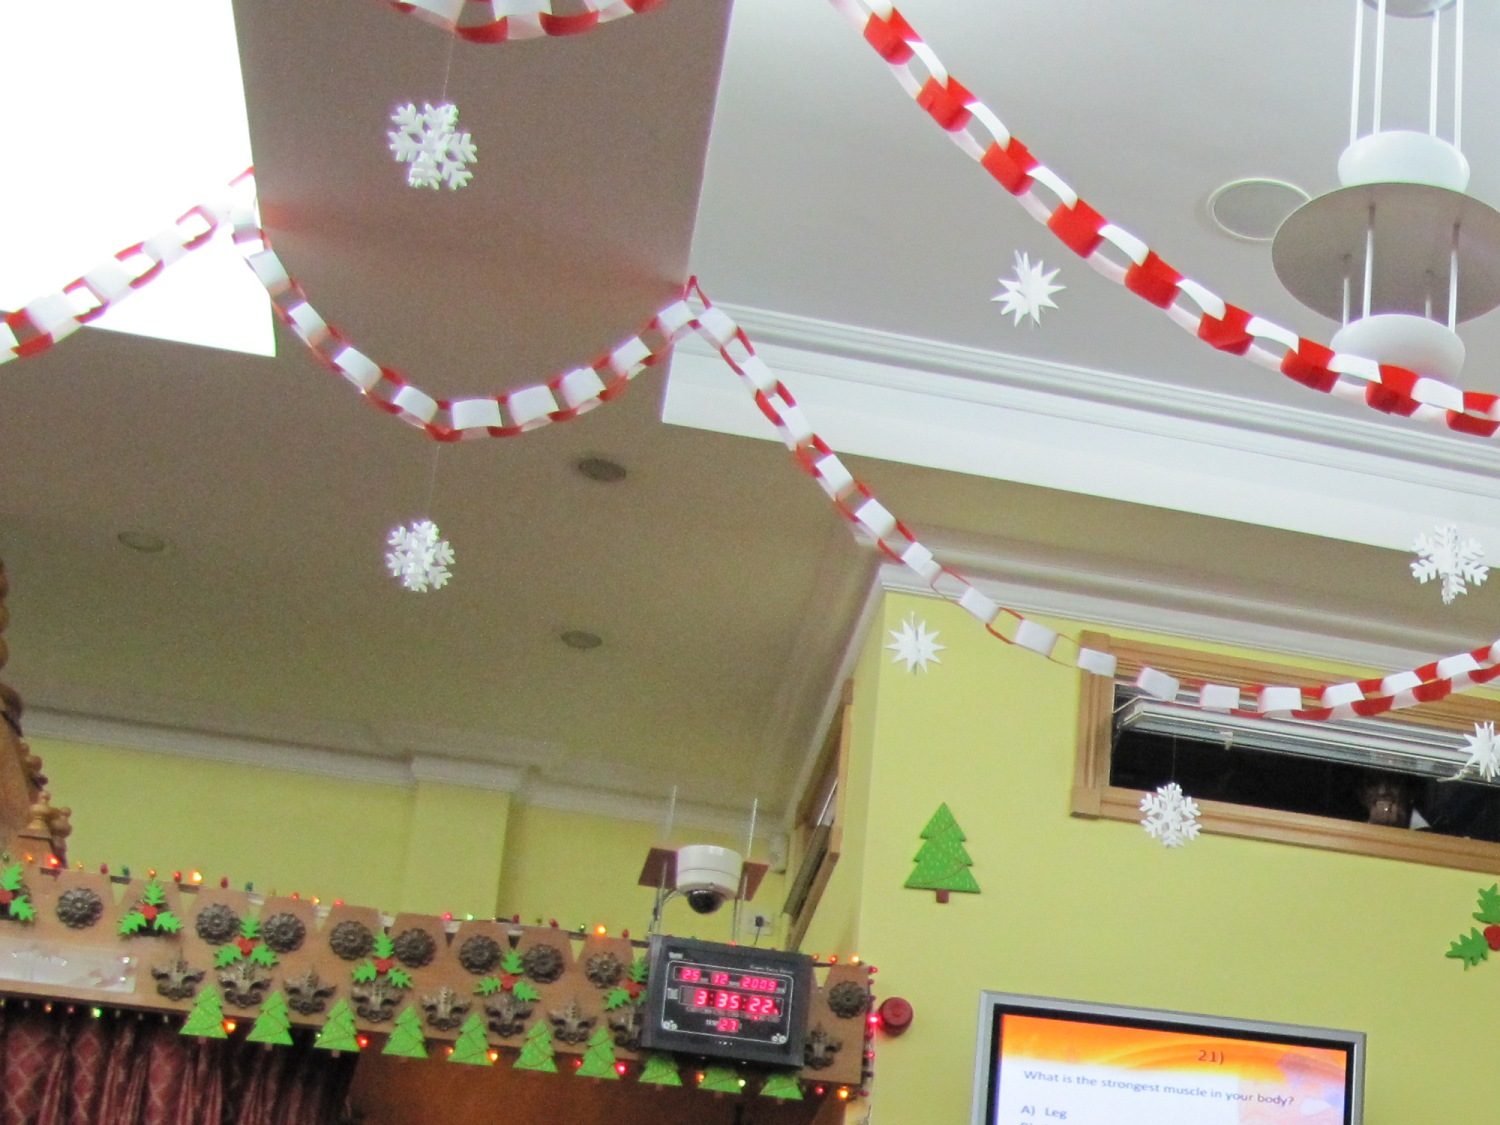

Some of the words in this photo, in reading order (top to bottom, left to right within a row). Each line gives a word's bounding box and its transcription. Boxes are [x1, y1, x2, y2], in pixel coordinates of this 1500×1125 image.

[682, 968, 701, 981] 25
[713, 972, 729, 985] 12
[741, 976, 778, 991] 2009
[718, 1018, 739, 1032] 27
[1198, 1049, 1225, 1065] 21)
[1023, 1070, 1059, 1082] What
[1063, 1074, 1073, 1084] is
[1076, 1076, 1097, 1086] the
[1101, 1078, 1160, 1093] strongest
[1163, 1085, 1208, 1097] muscle
[1210, 1088, 1222, 1098] in
[1225, 1092, 1254, 1102] your
[1257, 1093, 1295, 1107] body?
[1020, 1105, 1036, 1116] A)
[1045, 1107, 1068, 1120] Leg
